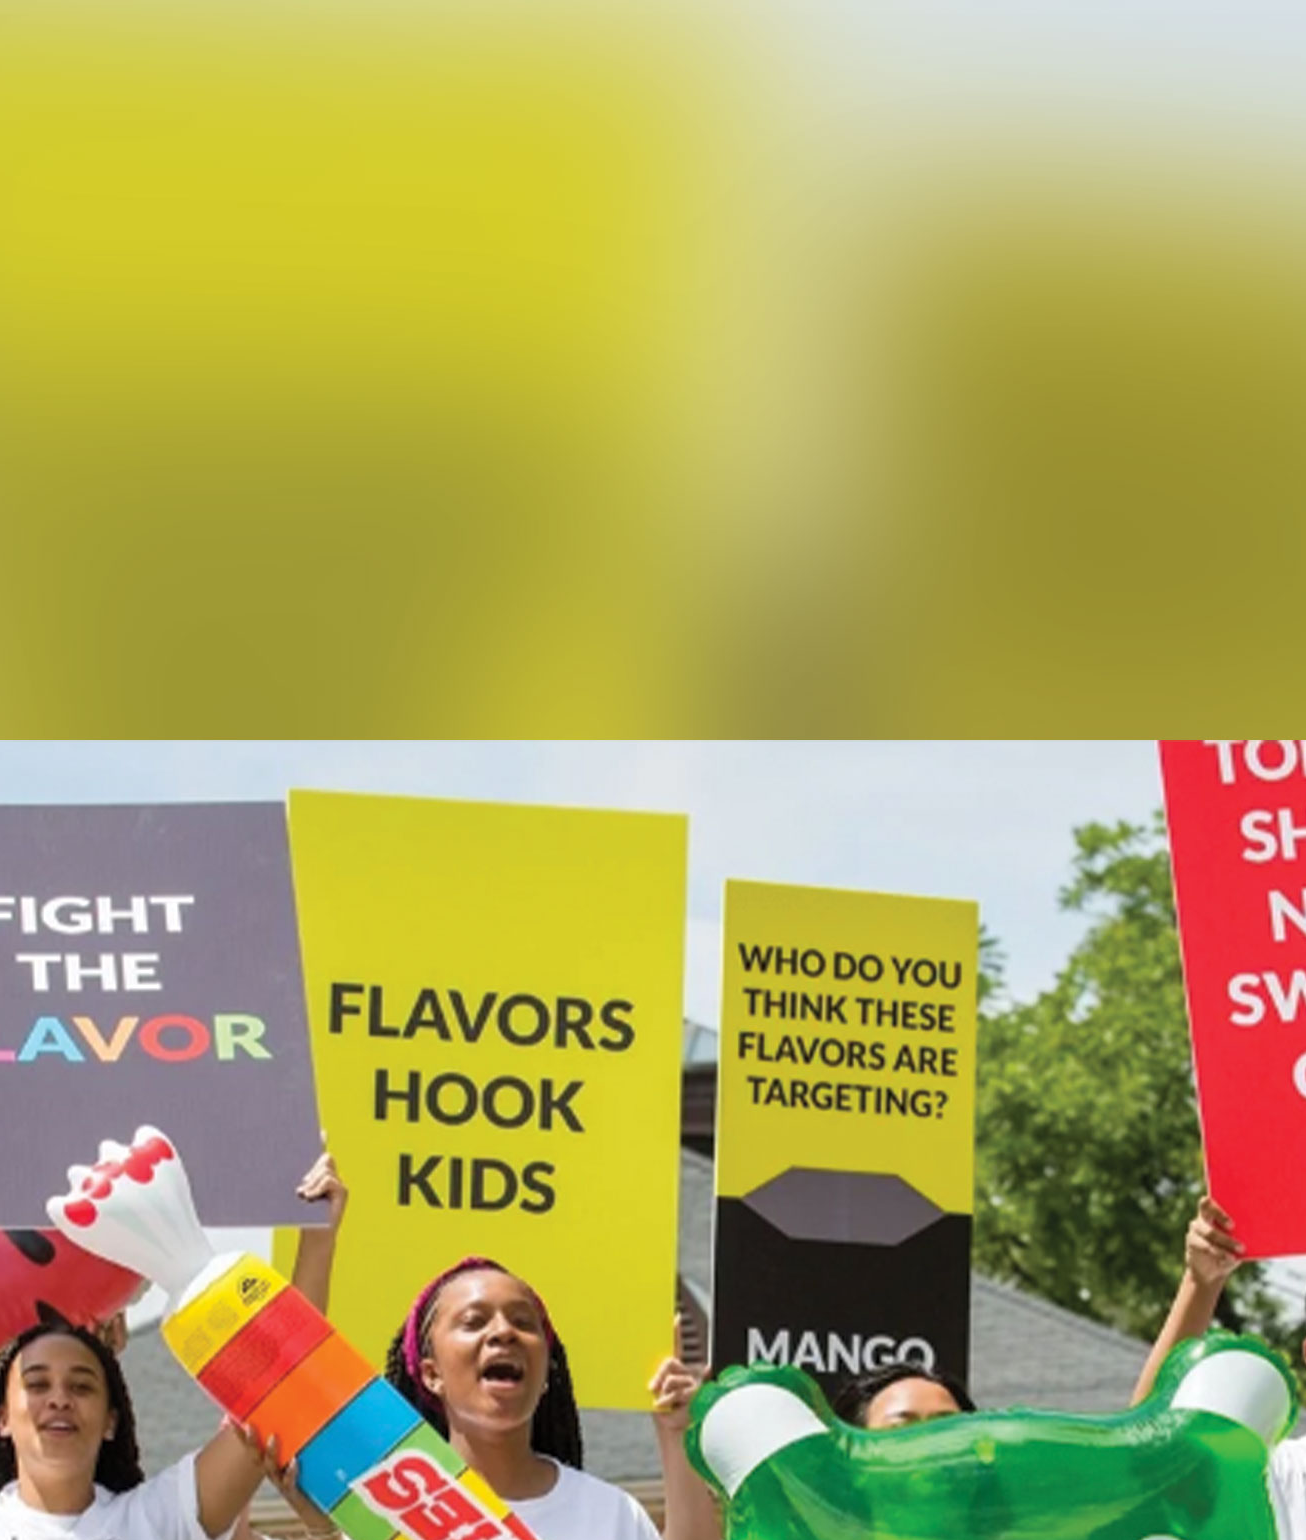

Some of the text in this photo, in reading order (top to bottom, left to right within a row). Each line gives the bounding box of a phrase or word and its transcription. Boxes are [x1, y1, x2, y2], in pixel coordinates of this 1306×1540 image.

[15, 953, 163, 992] THE
[738, 943, 961, 990] WHO DO YOU
[328, 982, 635, 1052] FLAVORS
[743, 988, 955, 1033] THINK THESE
[738, 1032, 957, 1077] FLAVORS ARE
[374, 1069, 585, 1133] HOOK
[747, 1075, 948, 1119] TARGETING?
[397, 1154, 556, 1214] KIDS
[747, 1327, 935, 1375] MANGO
